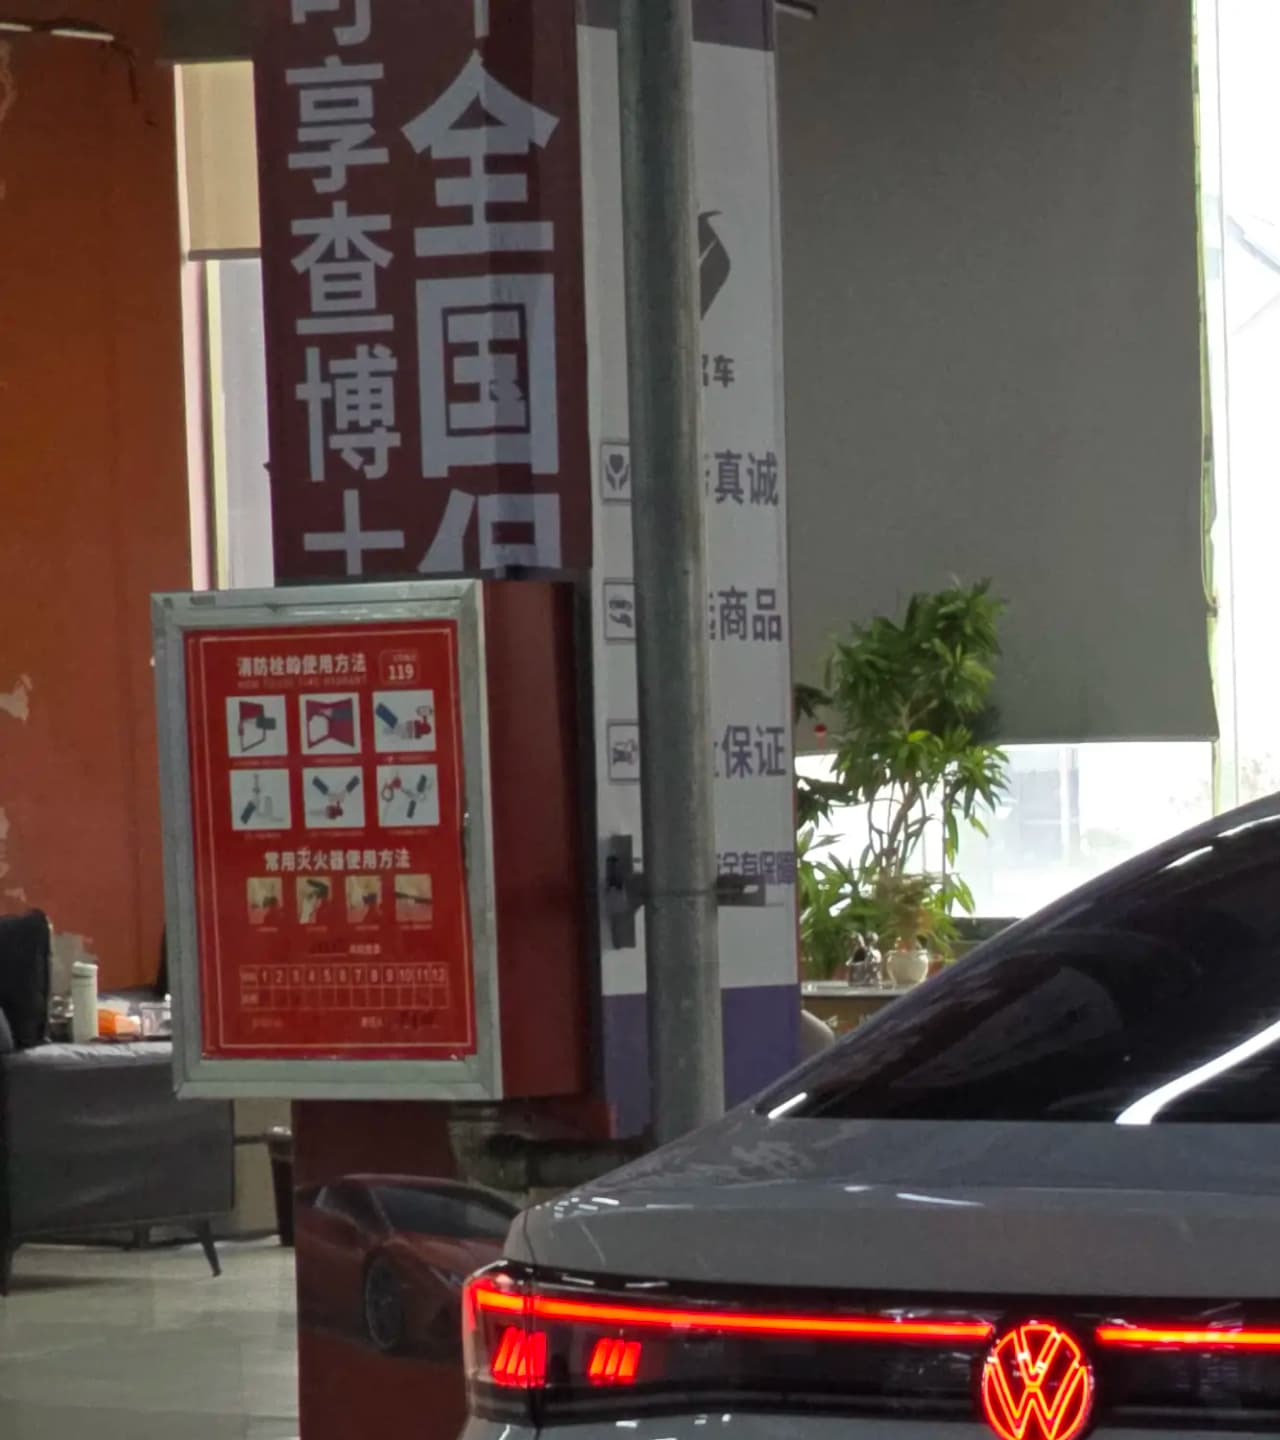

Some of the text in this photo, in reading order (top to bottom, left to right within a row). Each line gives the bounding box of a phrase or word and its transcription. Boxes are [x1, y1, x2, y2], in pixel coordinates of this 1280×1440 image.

[704, 450, 779, 506] 真诚
[709, 586, 783, 642] 商品
[237, 653, 367, 677] 消防栓的使用方法
[388, 663, 415, 681] 119
[714, 724, 787, 779] 保证
[264, 848, 411, 872] 常用灭火器使用方法
[399, 968, 413, 981] 10
[416, 968, 430, 981] 11
[432, 967, 446, 981] 12
